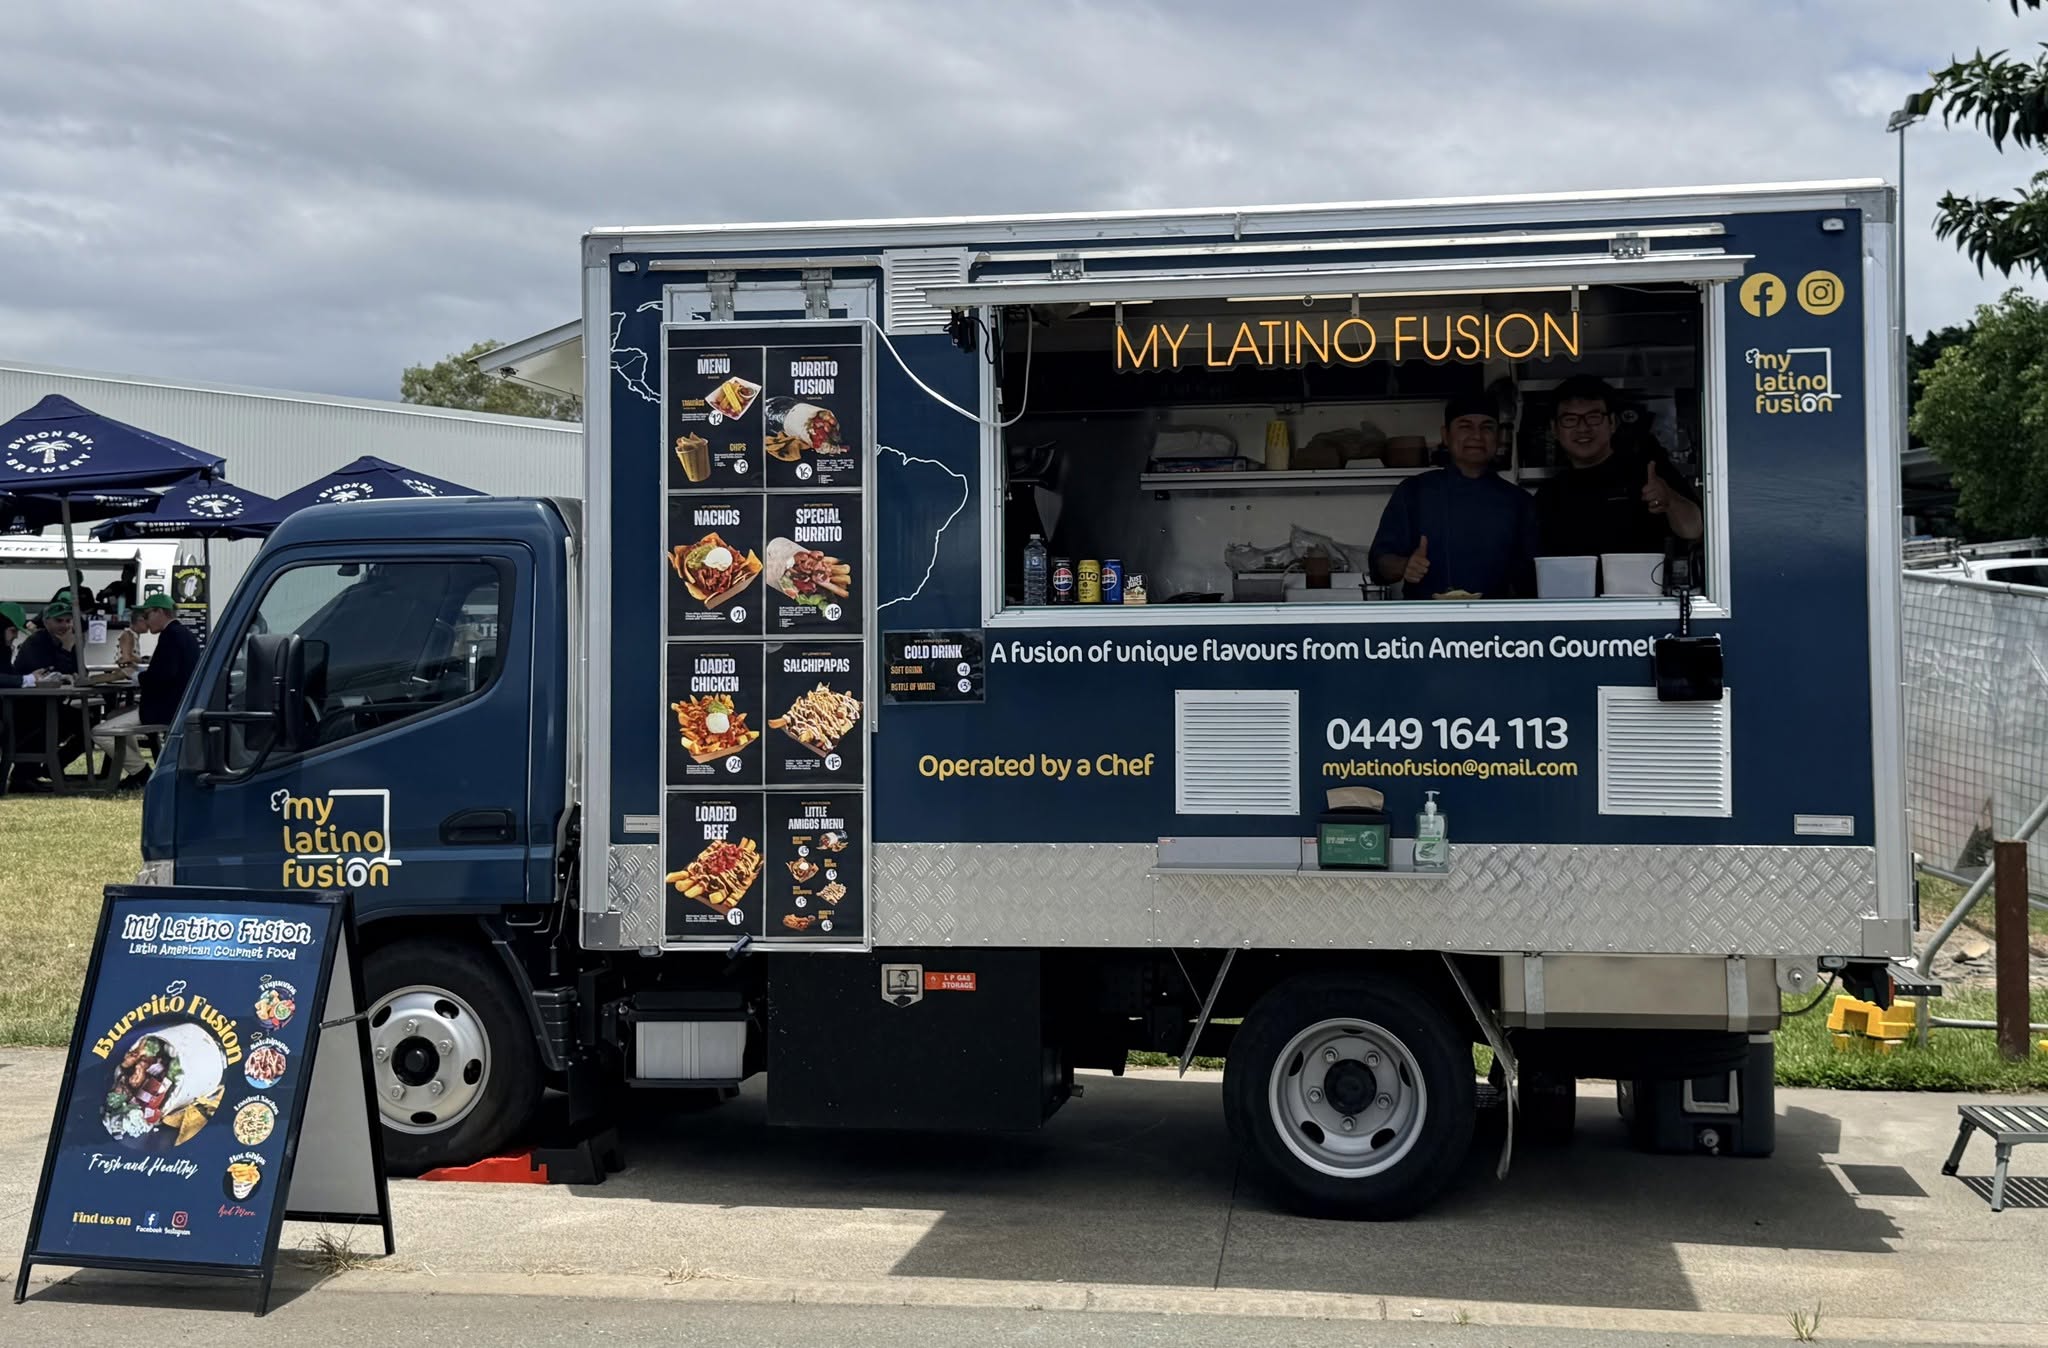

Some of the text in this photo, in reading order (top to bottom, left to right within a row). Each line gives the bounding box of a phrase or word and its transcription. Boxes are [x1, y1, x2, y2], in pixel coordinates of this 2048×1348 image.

[1117, 312, 1579, 369] MY LATINO FUSION
[697, 358, 731, 374] MENU
[790, 361, 838, 377] BURRITO
[1755, 353, 1791, 373] my
[794, 379, 835, 395] FUSION
[1755, 372, 1827, 391] latino
[1756, 393, 1833, 414] fusion
[8, 430, 94, 450] BYRON BAY
[729, 443, 747, 452] CHIPS
[6, 453, 91, 473] BREWERY
[319, 482, 360, 498] BYRON
[694, 509, 741, 526] NACHOS
[795, 508, 841, 524] SPECIAL
[794, 526, 842, 542] BURRITO
[1053, 575, 1073, 583] PEPSI
[1101, 575, 1116, 583] EPSI
[1126, 580, 1143, 589] JUICE
[1128, 574, 1142, 583] JUST
[904, 644, 963, 660] COLD DRINK
[990, 635, 1657, 667] A fusion of unique flavours from Latin American Gourmet
[694, 658, 736, 675] LOADED
[783, 658, 850, 673] SALCHIPAPAS
[890, 666, 923, 674] SOFT DRINK
[691, 676, 740, 692] CHICKEN
[890, 682, 936, 691] BOTTLE OF WATER
[1325, 717, 1569, 751] 0449 164 113
[918, 753, 1155, 782] Operated by a Chef
[1322, 759, 1578, 781] mylatinofusion@gmail.com
[282, 796, 334, 826] my
[695, 805, 737, 822] LOADED
[804, 806, 828, 818] LITTLE
[703, 824, 730, 840] BEEF
[788, 818, 845, 830] AMIGOS MENU
[282, 824, 384, 854] latino
[282, 857, 389, 888] fusion
[121, 914, 312, 944] My Latino Fusion
[129, 942, 297, 960] Latin American Gourmet Food
[93, 994, 244, 1066] Burrito Fusion
[87, 1153, 200, 1180] Fresh and Healthy
[228, 1151, 267, 1166] Hot Chips
[72, 1211, 132, 1226] Find us on
[135, 1225, 191, 1237] Facebook Instagram
